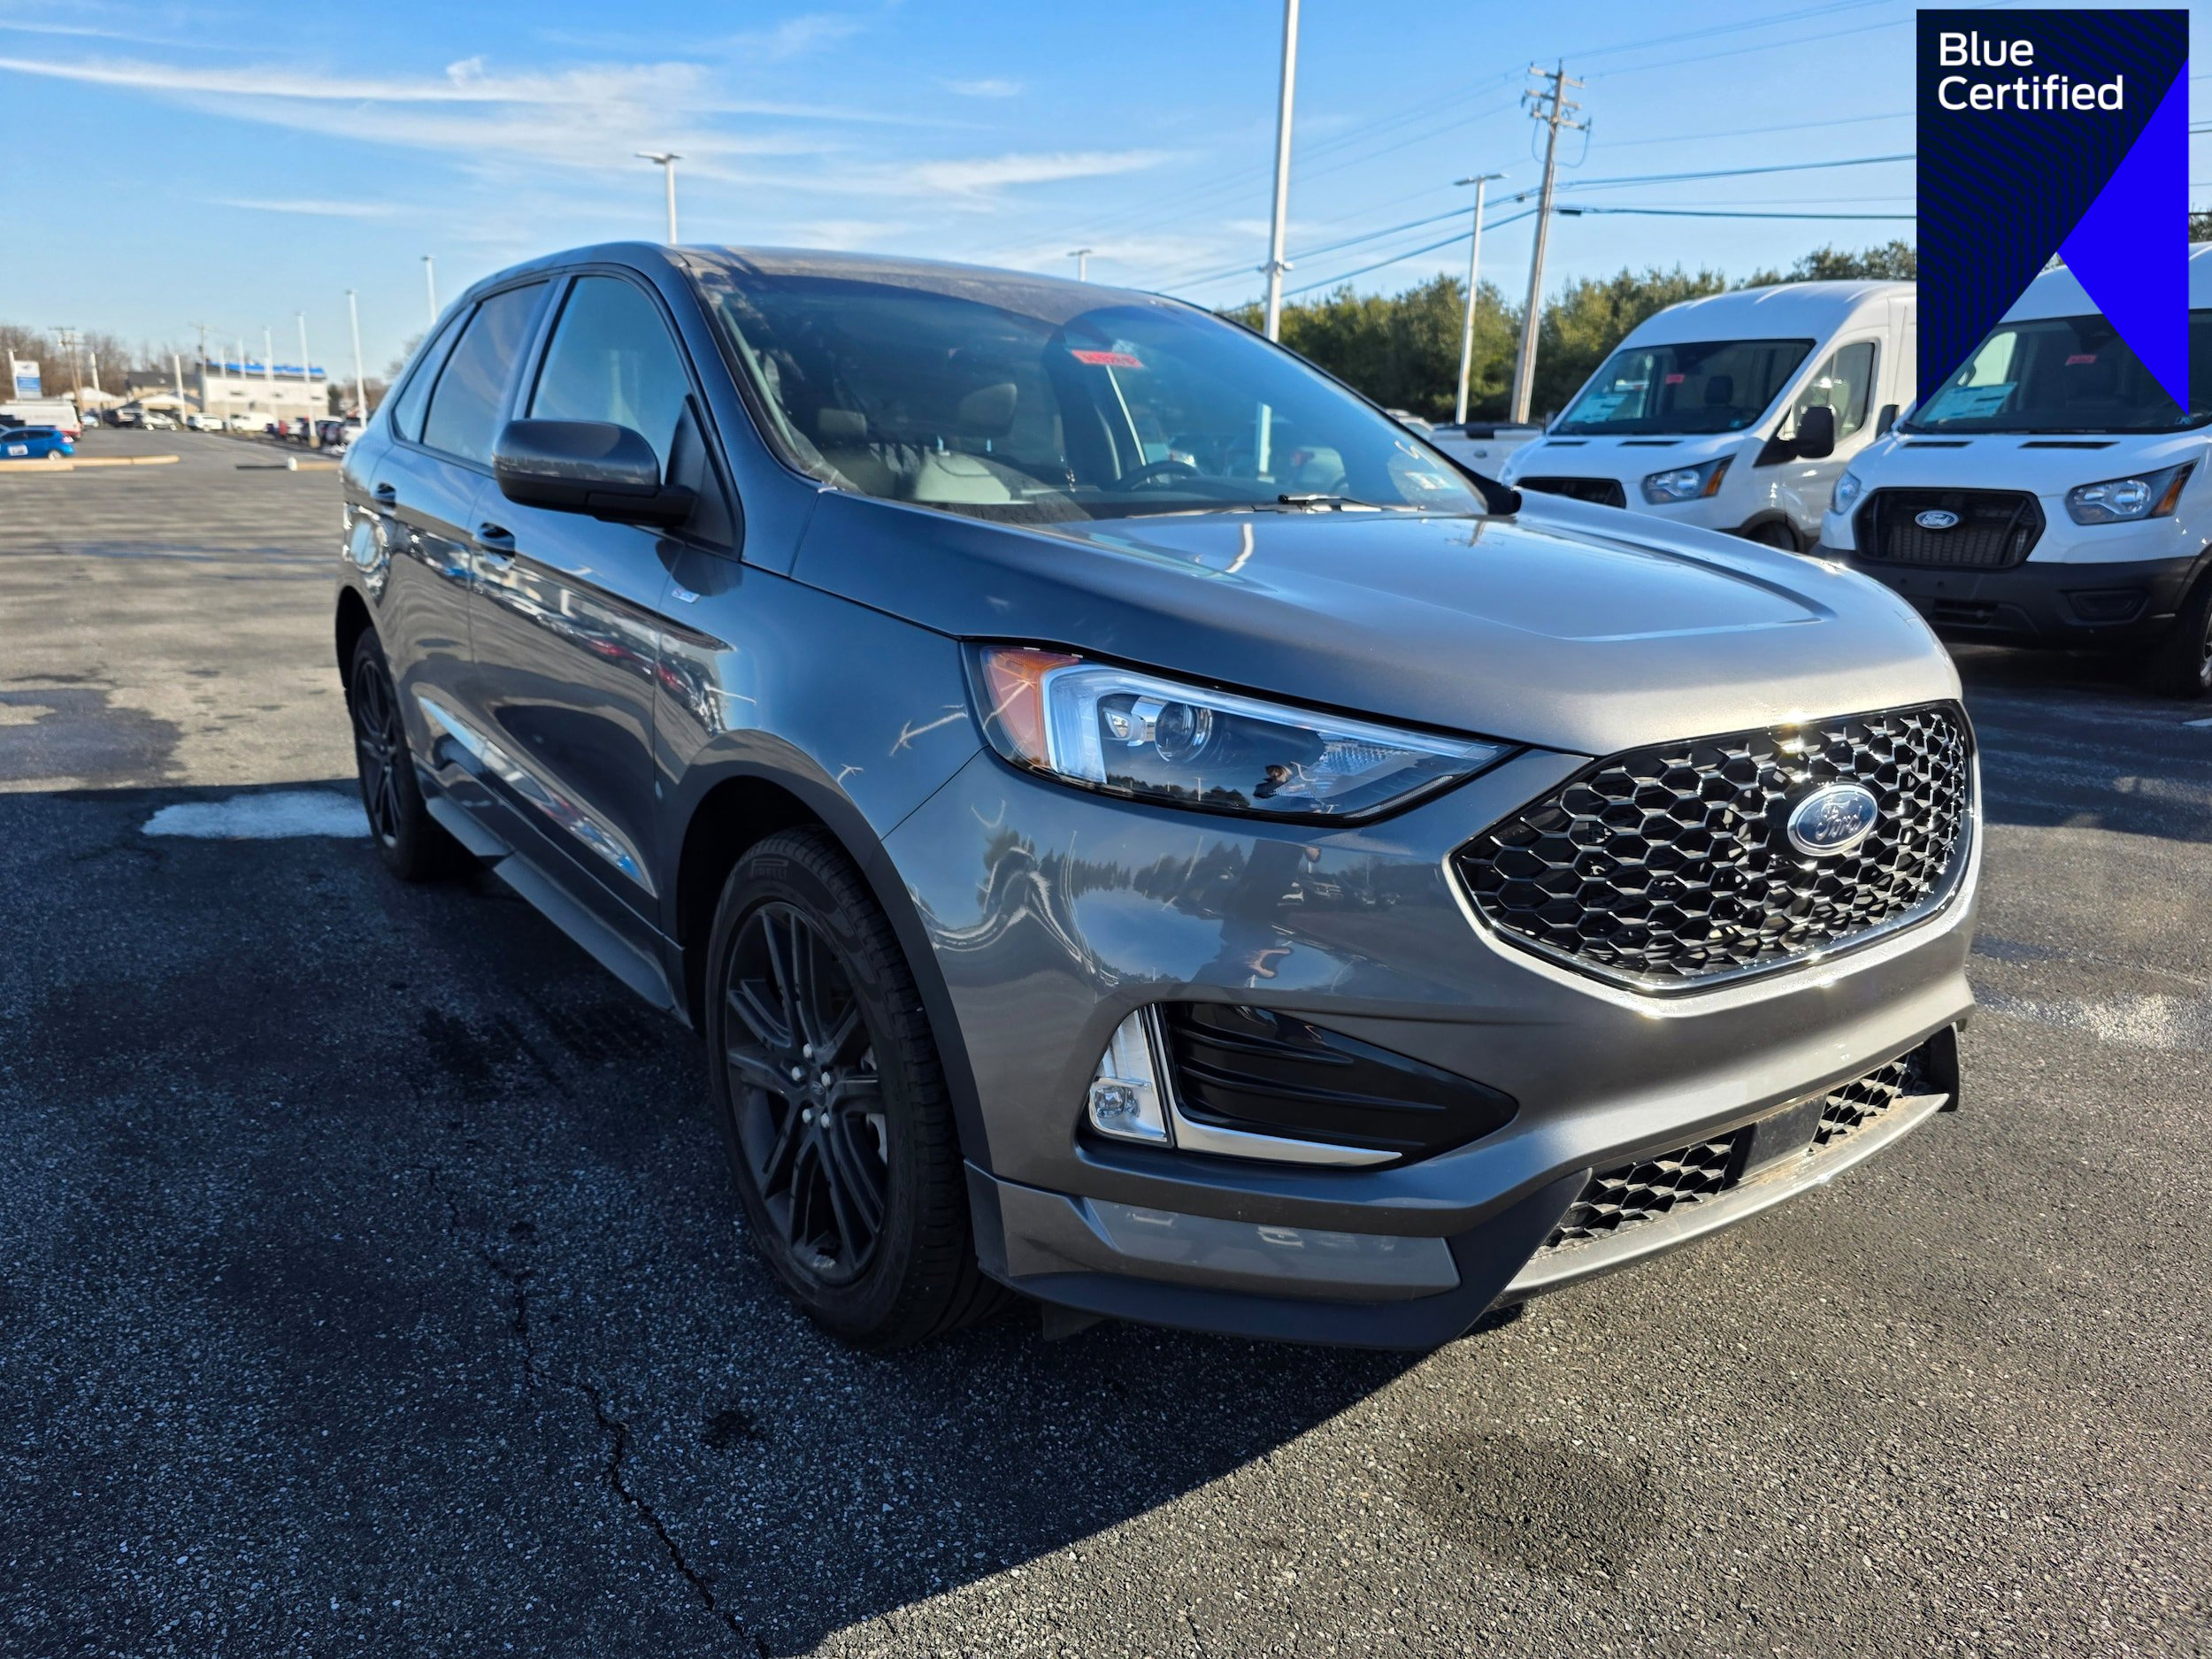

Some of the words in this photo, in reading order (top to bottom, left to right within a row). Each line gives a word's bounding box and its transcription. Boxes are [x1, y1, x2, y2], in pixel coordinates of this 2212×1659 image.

[1921, 512, 1952, 526] Ford
[1815, 799, 1863, 841] Ford
[750, 857, 788, 879] PIRELLI
